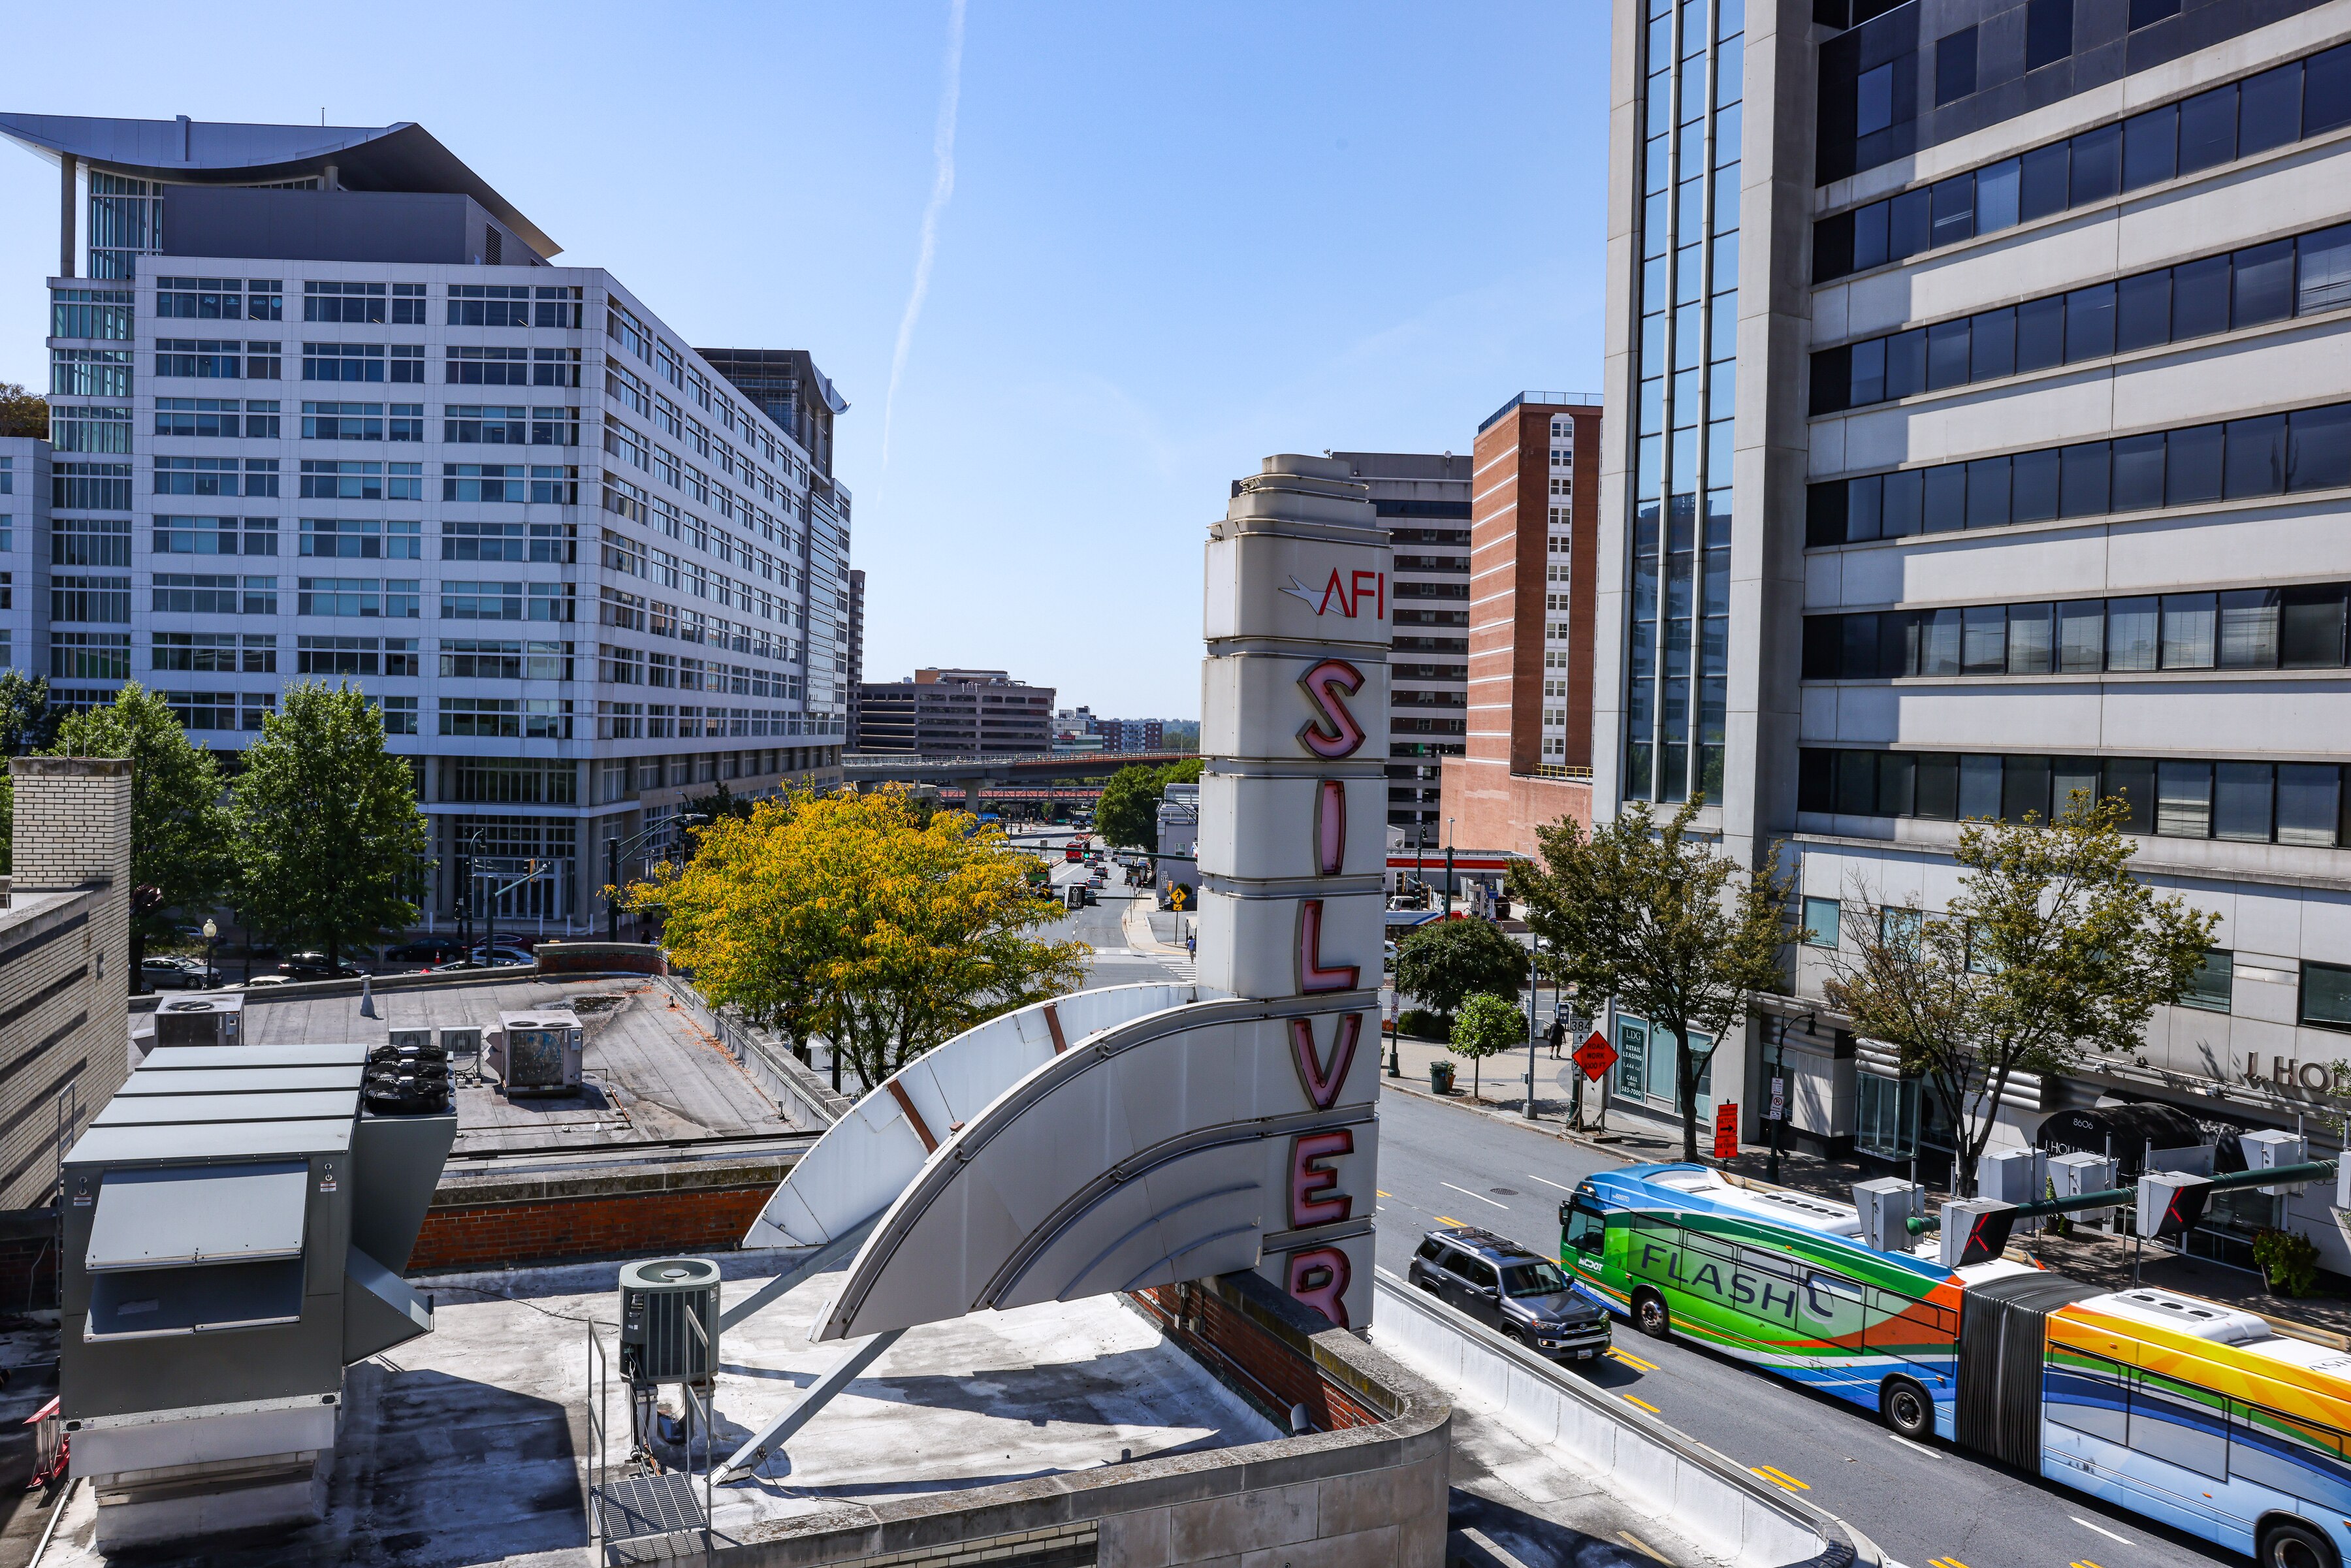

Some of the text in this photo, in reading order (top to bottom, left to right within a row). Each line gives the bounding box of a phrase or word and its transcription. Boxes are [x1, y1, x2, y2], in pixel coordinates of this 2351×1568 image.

[1318, 567, 1384, 620] AFI
[1283, 658, 1366, 1332] SILVER
[1571, 1021, 1591, 1031] 384
[1626, 1029, 1640, 1041] LDG
[1625, 1044, 1640, 1053] RETAIL
[1623, 1051, 1642, 1061] LEASING
[1626, 1074, 1638, 1083] CALL
[1621, 1085, 1641, 1096] 585-7000
[2073, 1118, 2094, 1130] 8606
[1641, 1243, 1796, 1319] FLASH
